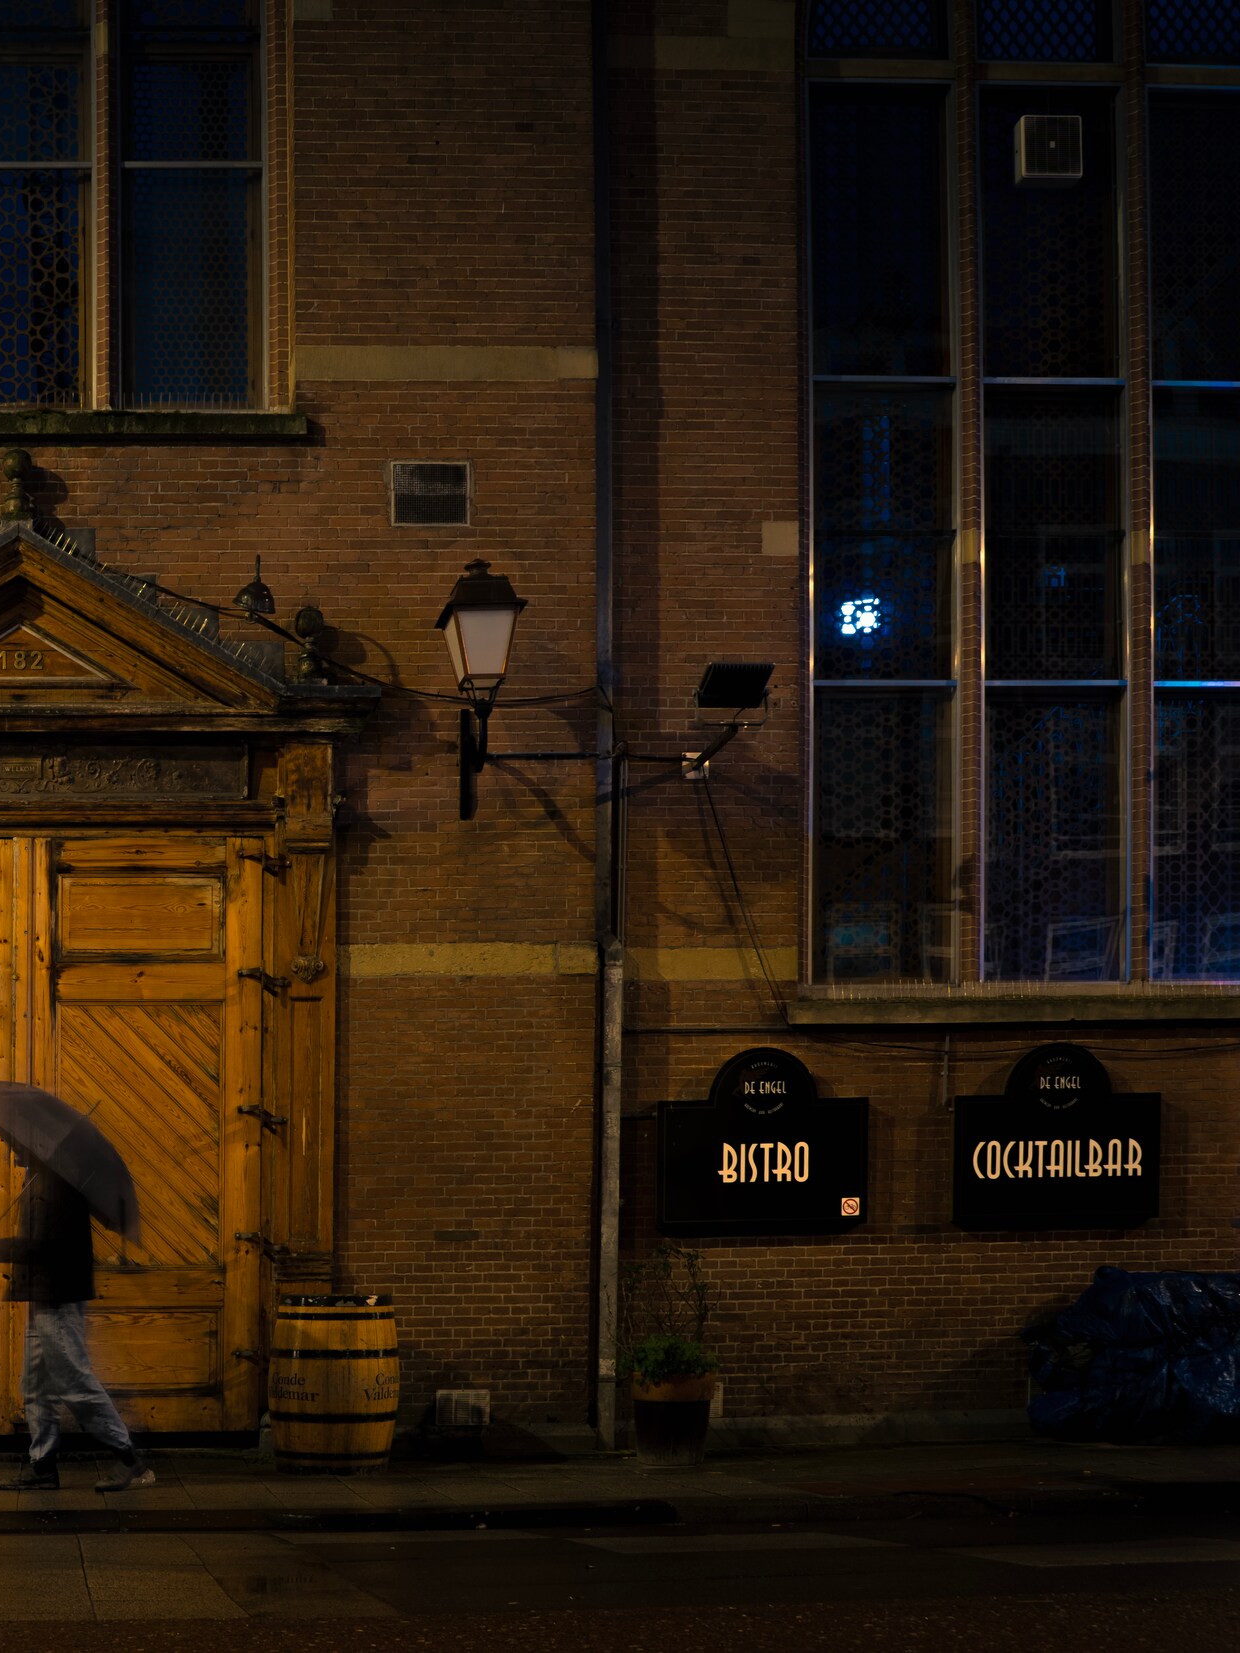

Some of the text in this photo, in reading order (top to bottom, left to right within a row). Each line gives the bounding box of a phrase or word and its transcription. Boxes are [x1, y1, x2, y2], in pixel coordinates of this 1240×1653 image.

[0, 650, 43, 670] 182
[744, 1081, 787, 1095] DE ENGEL
[1039, 1076, 1081, 1090] DE ENGEL
[717, 1141, 810, 1184] BISTRO
[972, 1138, 1142, 1180] COCKTAILBAR
